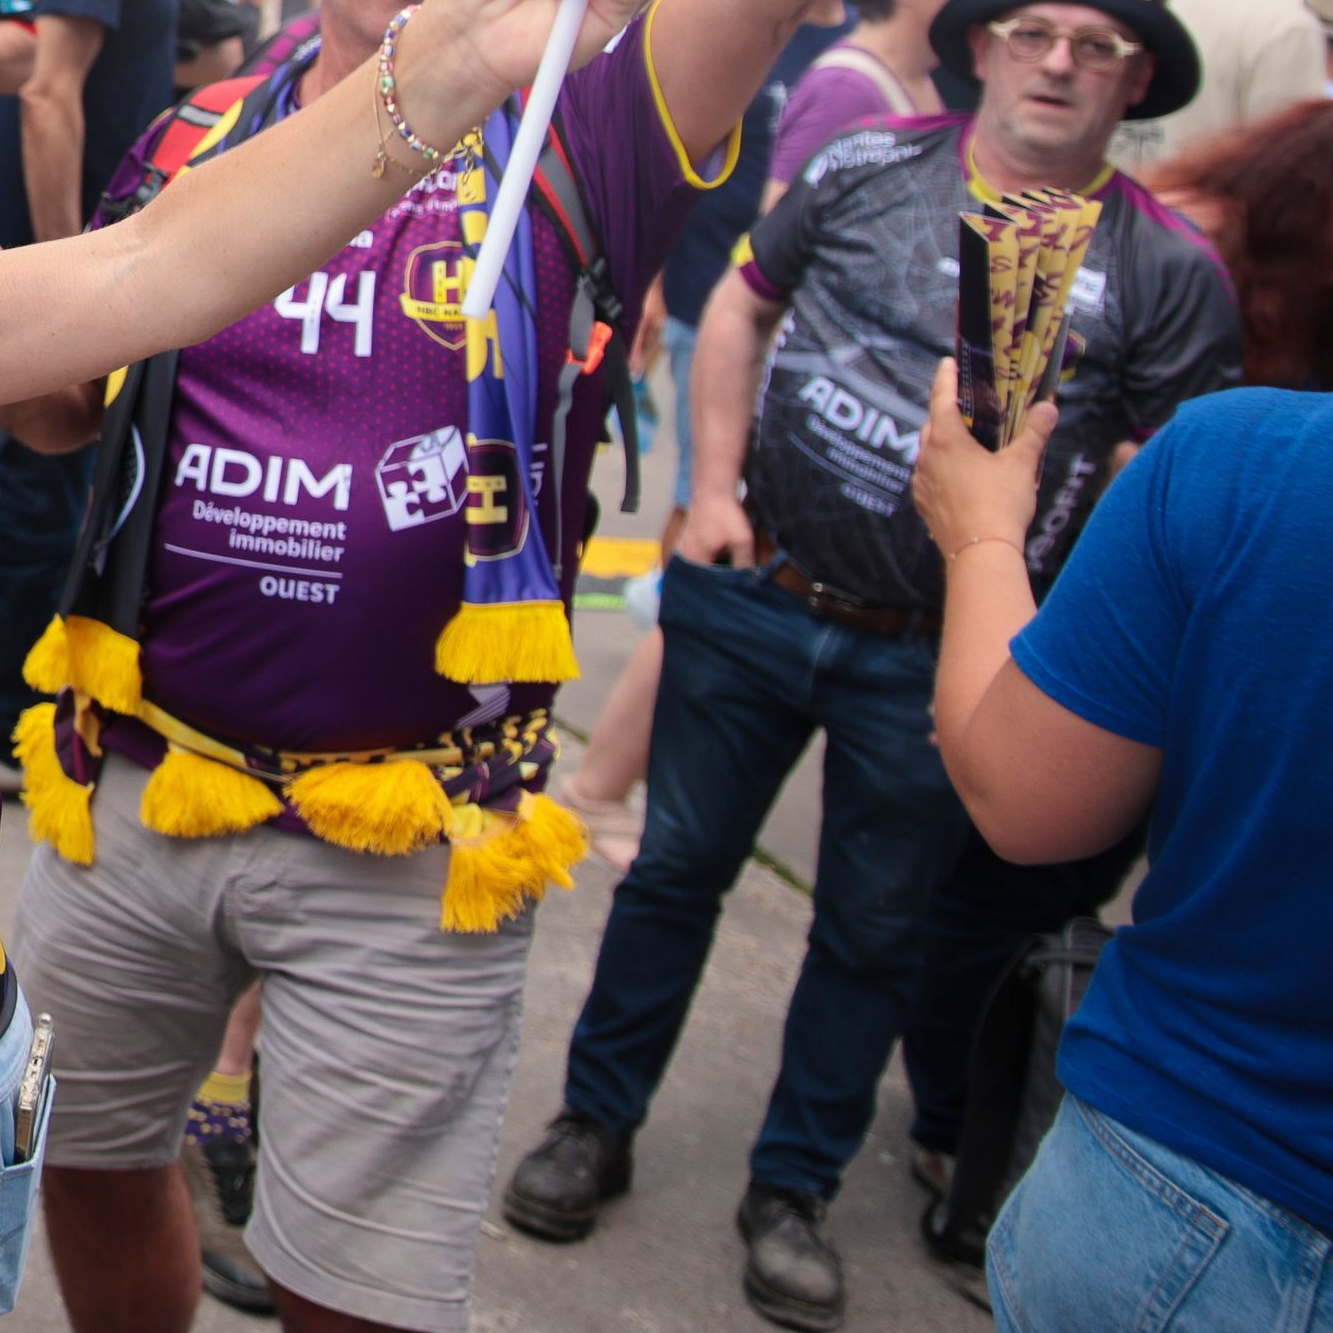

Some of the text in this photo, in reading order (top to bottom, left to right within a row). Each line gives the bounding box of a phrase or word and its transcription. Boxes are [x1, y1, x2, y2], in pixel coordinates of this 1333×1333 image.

[273, 271, 376, 357] 44
[175, 443, 354, 511] ADIM
[192, 499, 347, 541] Développement
[229, 528, 345, 562] immobilier
[260, 575, 340, 604] OUEST
